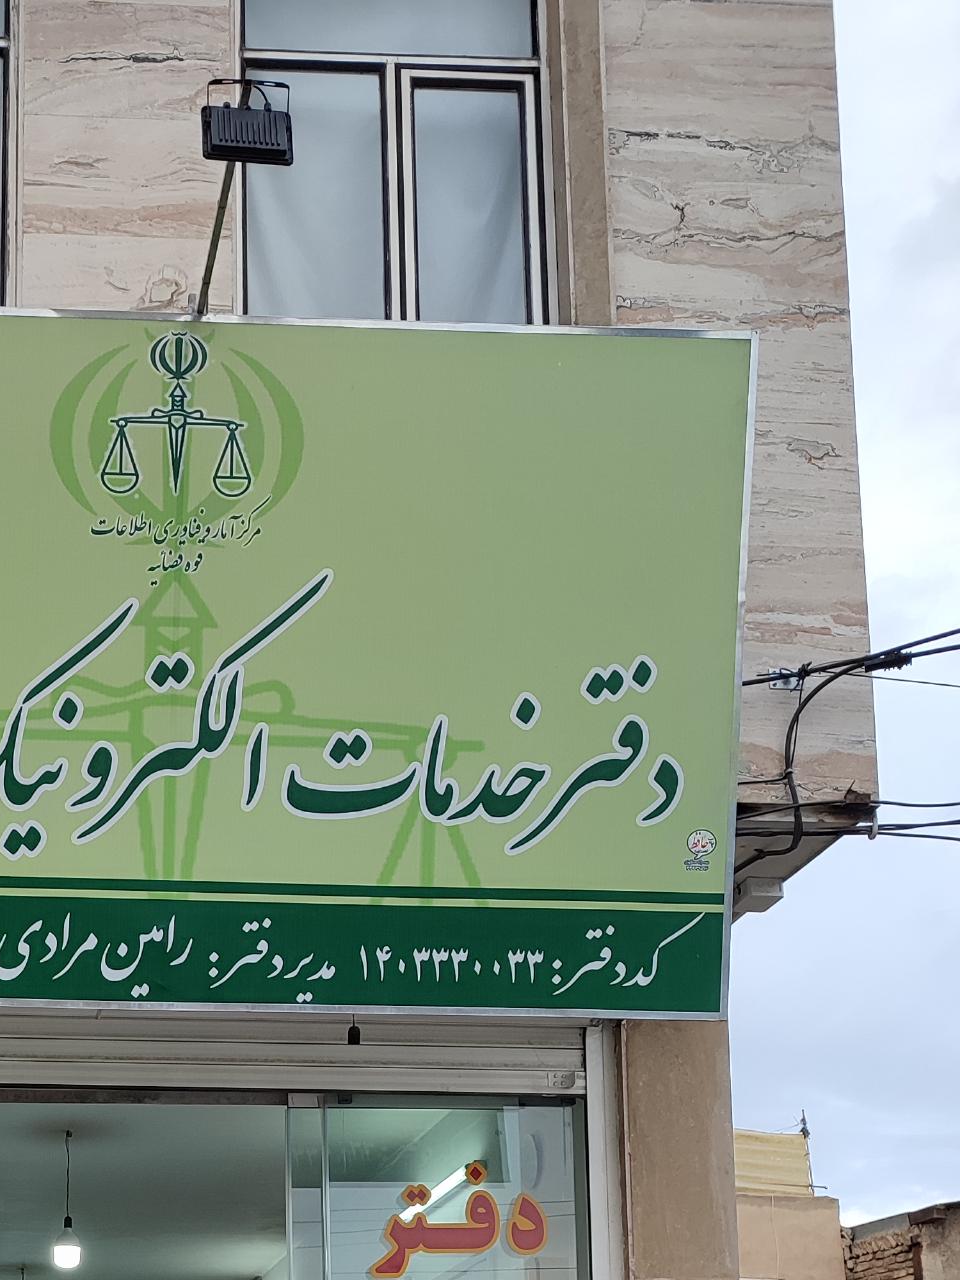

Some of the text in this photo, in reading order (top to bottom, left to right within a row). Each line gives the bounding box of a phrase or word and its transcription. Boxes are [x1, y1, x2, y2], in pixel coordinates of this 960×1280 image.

[90, 512, 152, 537] اطلاعات
[236, 494, 272, 547] مرکز
[184, 551, 204, 573] قوه
[285, 692, 545, 826] خدمات
[503, 655, 684, 854] دفتر
[100, 914, 194, 1000] رامین
[283, 952, 337, 1004] مدیر
[358, 944, 545, 985] ۱۴۰۳۳۳۰۰۳۳
[621, 911, 708, 988] کد
[369, 1158, 548, 1280] دفتر
